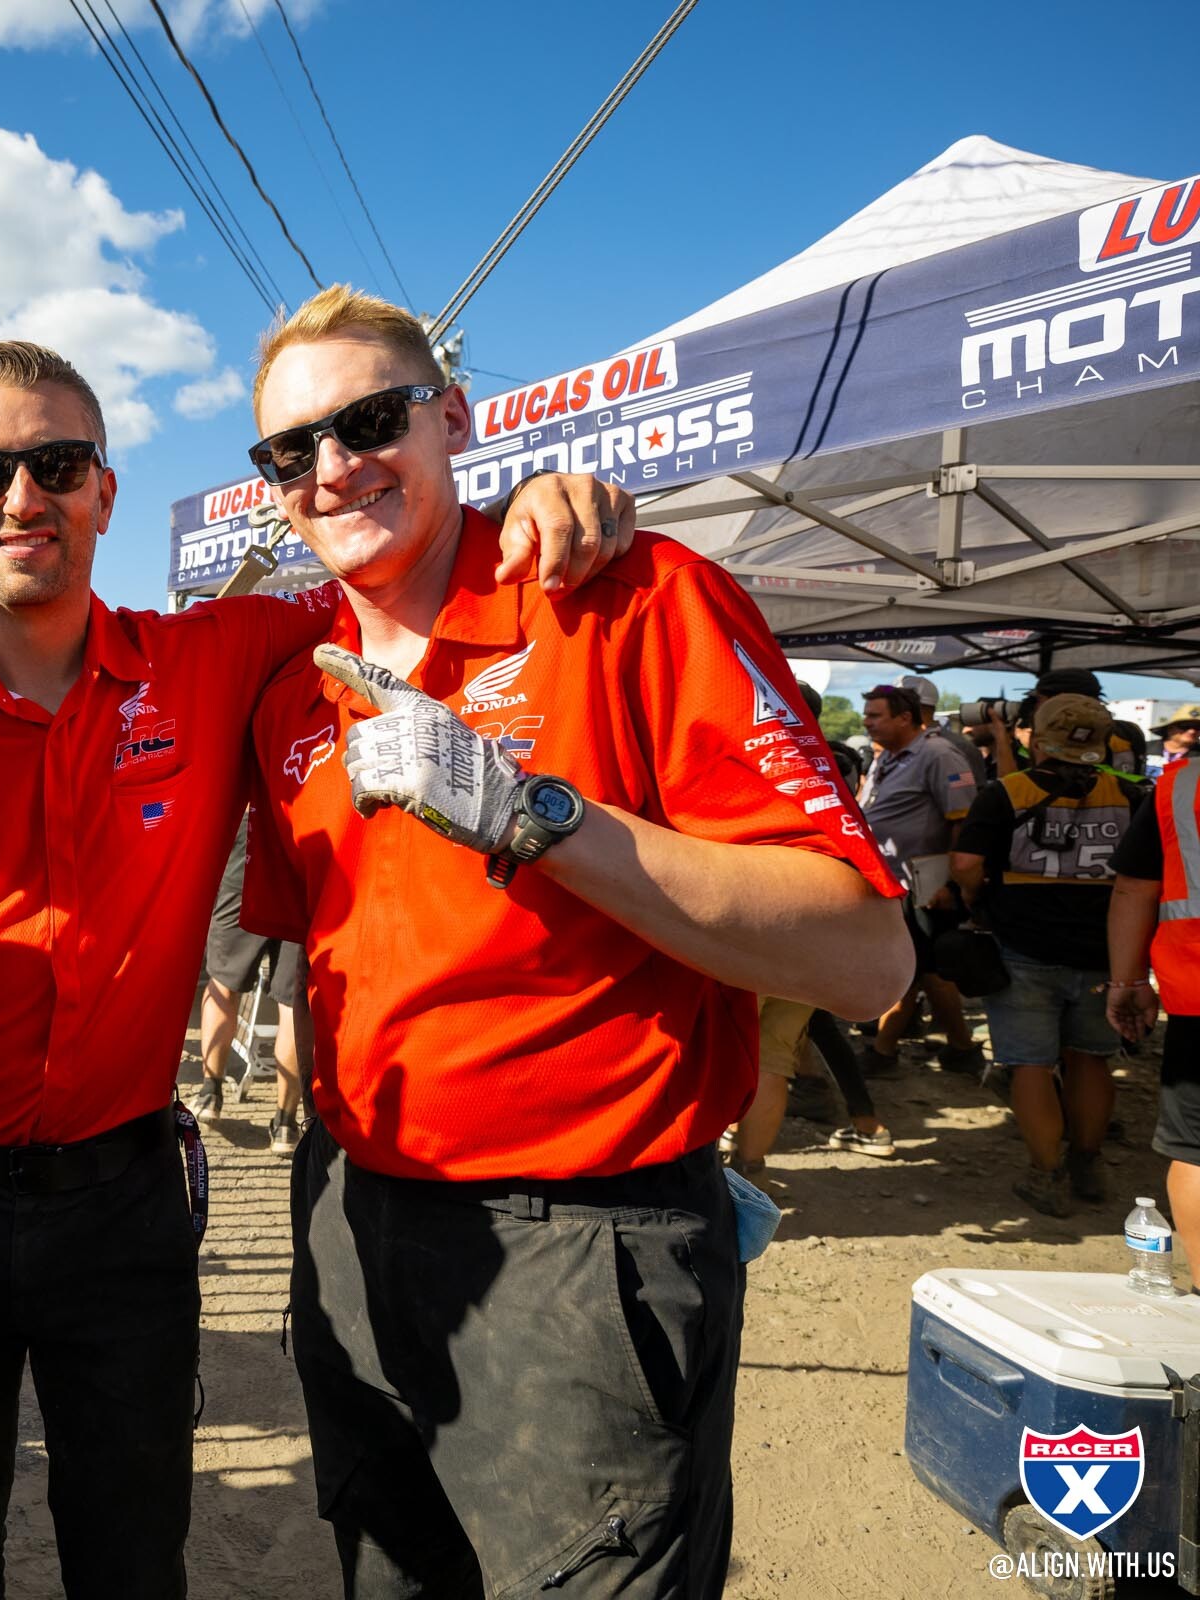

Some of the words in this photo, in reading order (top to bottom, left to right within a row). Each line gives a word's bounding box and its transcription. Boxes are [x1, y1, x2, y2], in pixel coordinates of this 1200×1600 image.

[484, 368, 595, 438] LUCAS
[602, 346, 667, 401] OIL
[529, 410, 614, 447] PRO
[208, 479, 266, 521] LUCAS
[460, 692, 528, 716] HONDA
